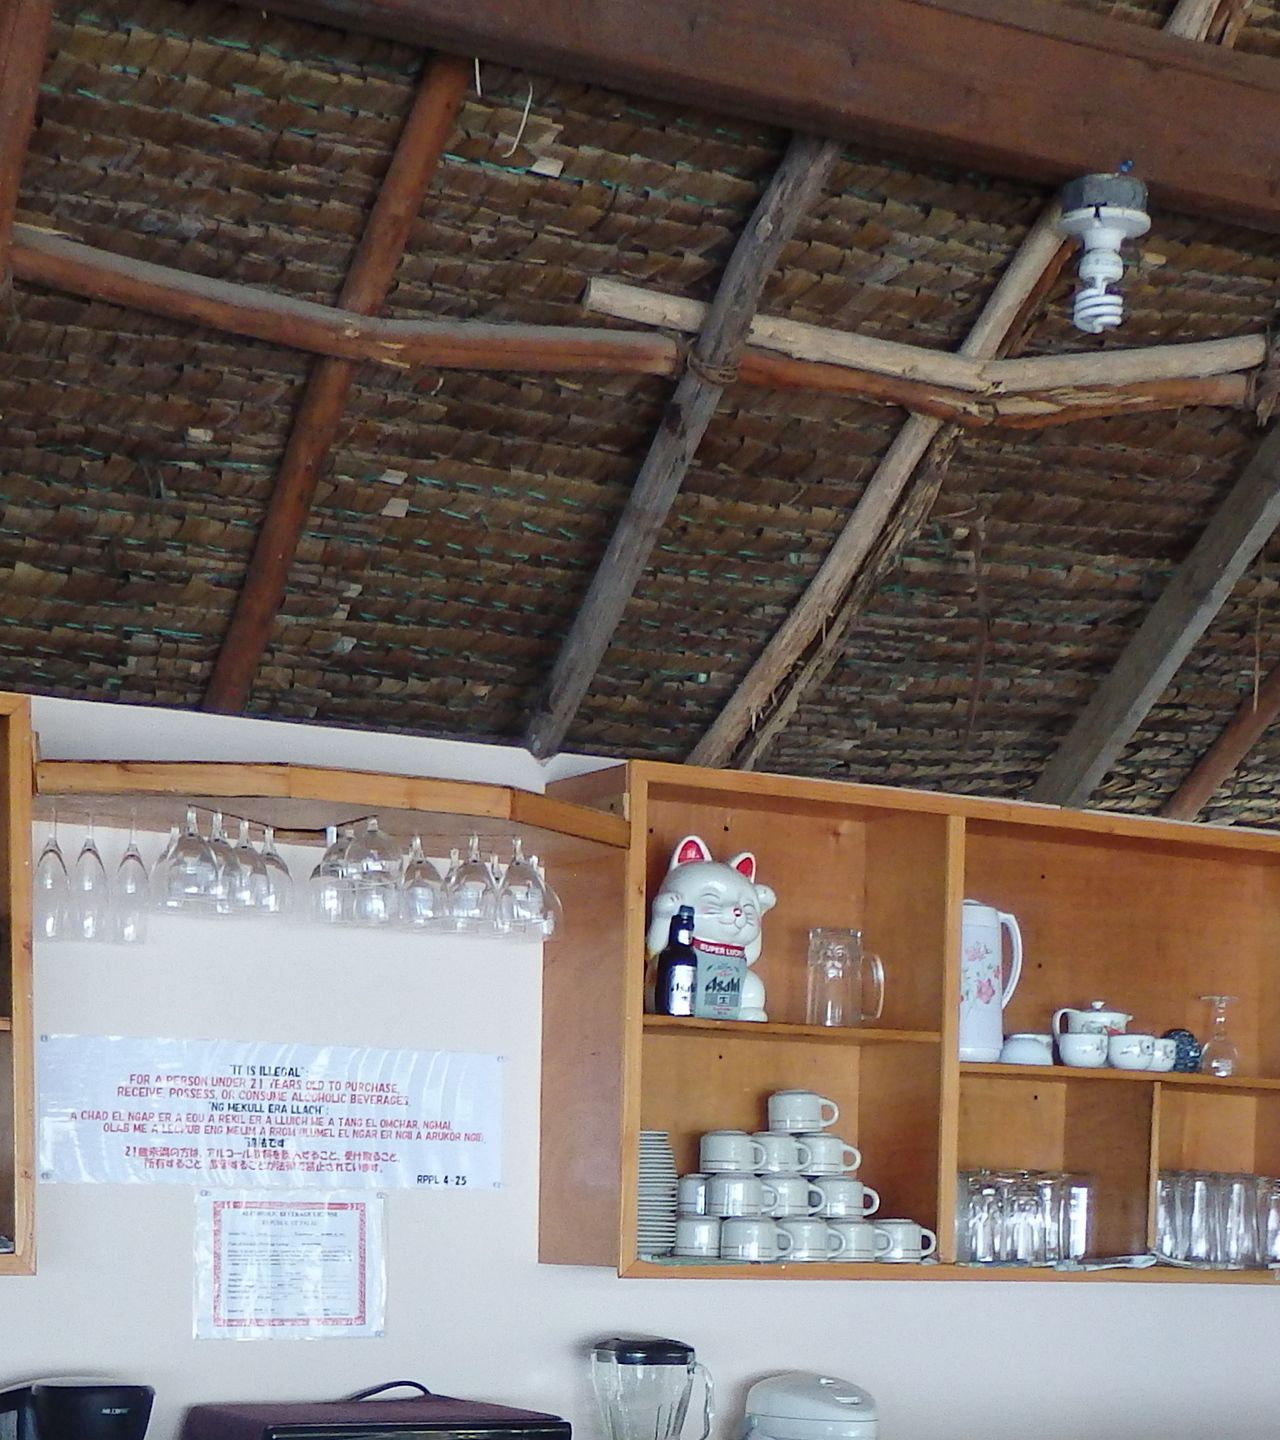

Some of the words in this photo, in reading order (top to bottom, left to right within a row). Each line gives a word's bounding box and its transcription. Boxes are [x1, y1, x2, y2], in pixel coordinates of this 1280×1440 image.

[700, 943, 725, 955] SUPER
[705, 976, 740, 993] Asahi
[247, 1065, 256, 1076] IS
[129, 1074, 150, 1085] FOR
[155, 1075, 162, 1084] A
[166, 1075, 208, 1087] PERSON
[211, 1076, 246, 1088] UNDER
[250, 1078, 263, 1089] 21
[269, 1078, 302, 1090] YEARS
[306, 1080, 324, 1091] OLD
[329, 1081, 341, 1091] TO
[239, 1090, 288, 1102] CONSUME
[291, 1092, 347, 1104] ALCOHOLIC
[268, 1104, 288, 1114] ERA
[70, 1112, 78, 1121] A
[81, 1110, 109, 1121] CHAD
[112, 1111, 124, 1121] EL
[158, 1112, 172, 1122] ER
[175, 1113, 182, 1122] A
[208, 1113, 215, 1123] A
[249, 1115, 262, 1125] ER
[265, 1115, 272, 1125] A
[328, 1117, 335, 1126] A
[365, 1118, 378, 1128] EL
[133, 1123, 148, 1133] ME
[204, 1125, 223, 1135] ENG
[259, 1126, 266, 1136] A
[338, 1128, 349, 1138] EL
[352, 1129, 378, 1139] NGAR
[380, 1129, 393, 1140] ER
[415, 1131, 422, 1140] A
[425, 1131, 461, 1141] ARUKOR
[416, 1174, 439, 1184] RPPL
